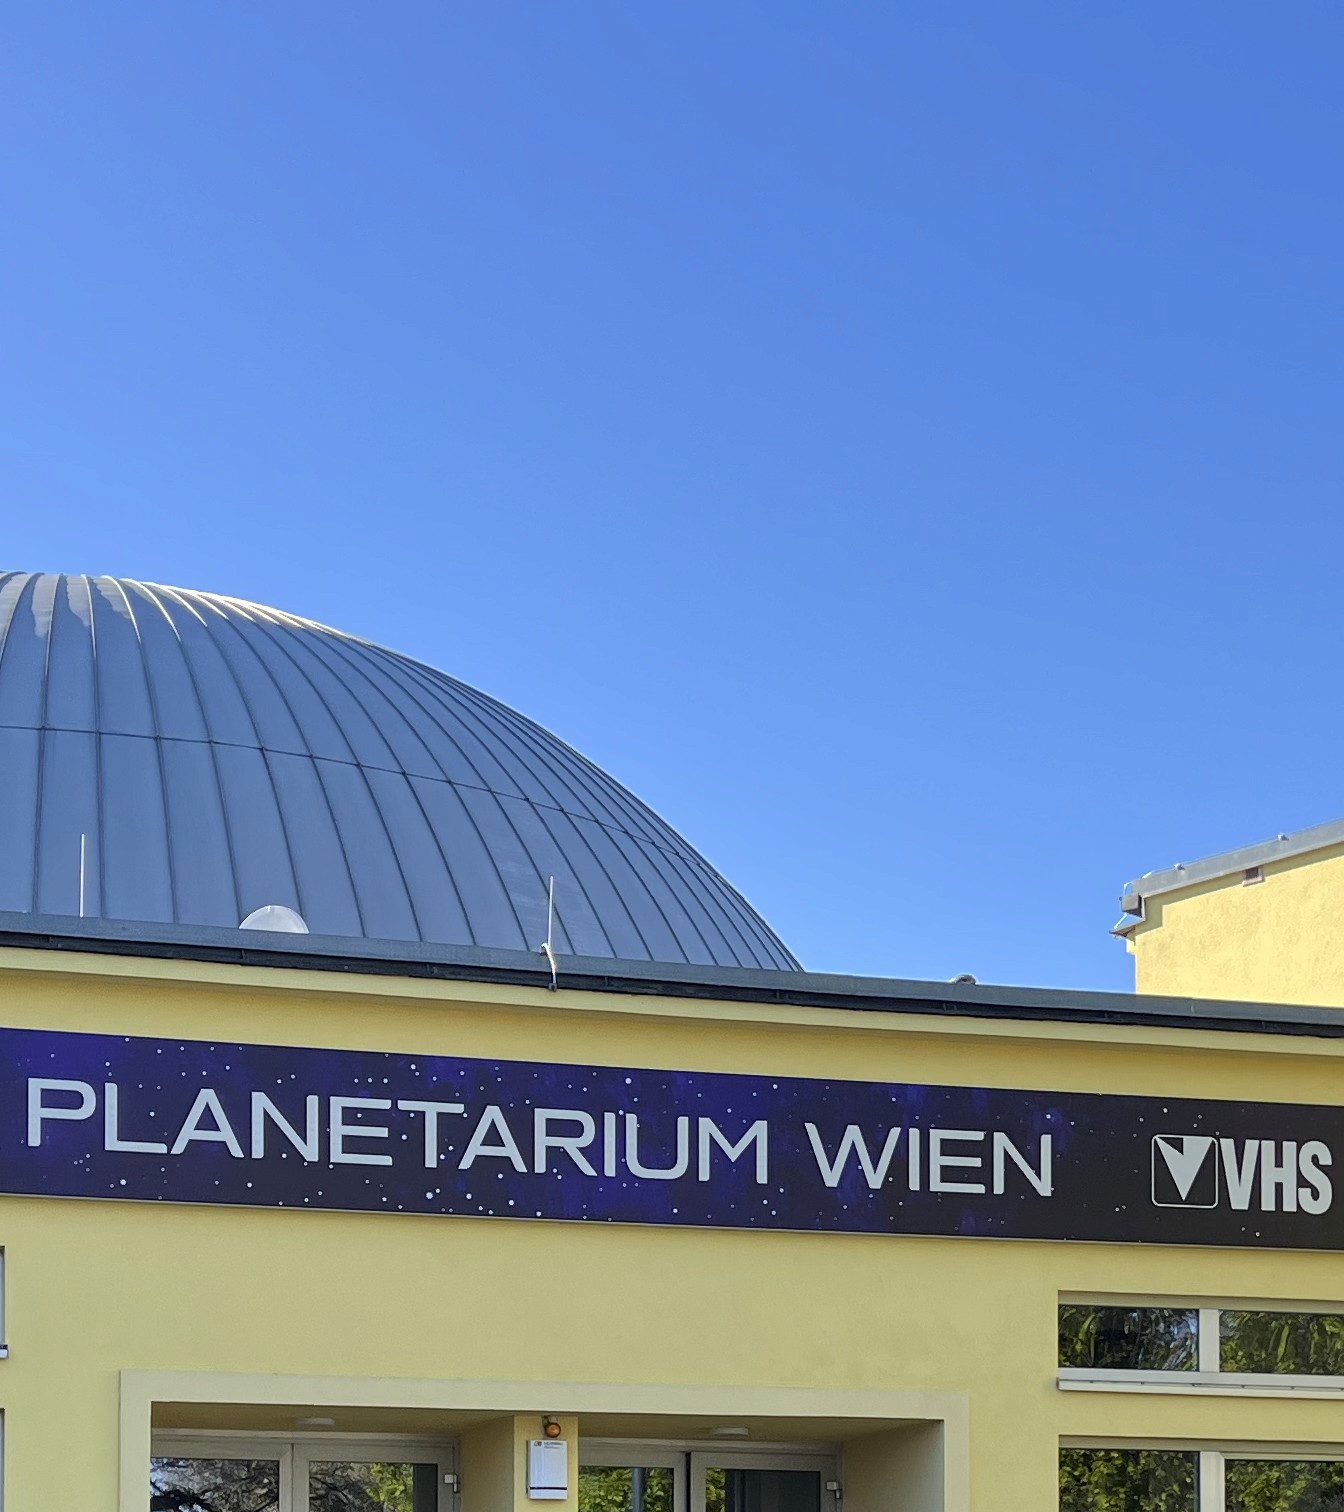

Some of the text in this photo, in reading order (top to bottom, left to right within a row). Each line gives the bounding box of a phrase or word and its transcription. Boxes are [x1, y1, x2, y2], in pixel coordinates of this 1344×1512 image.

[26, 1076, 1054, 1198] PLANETARIUM WIEN
[1221, 1137, 1334, 1216] VHS
